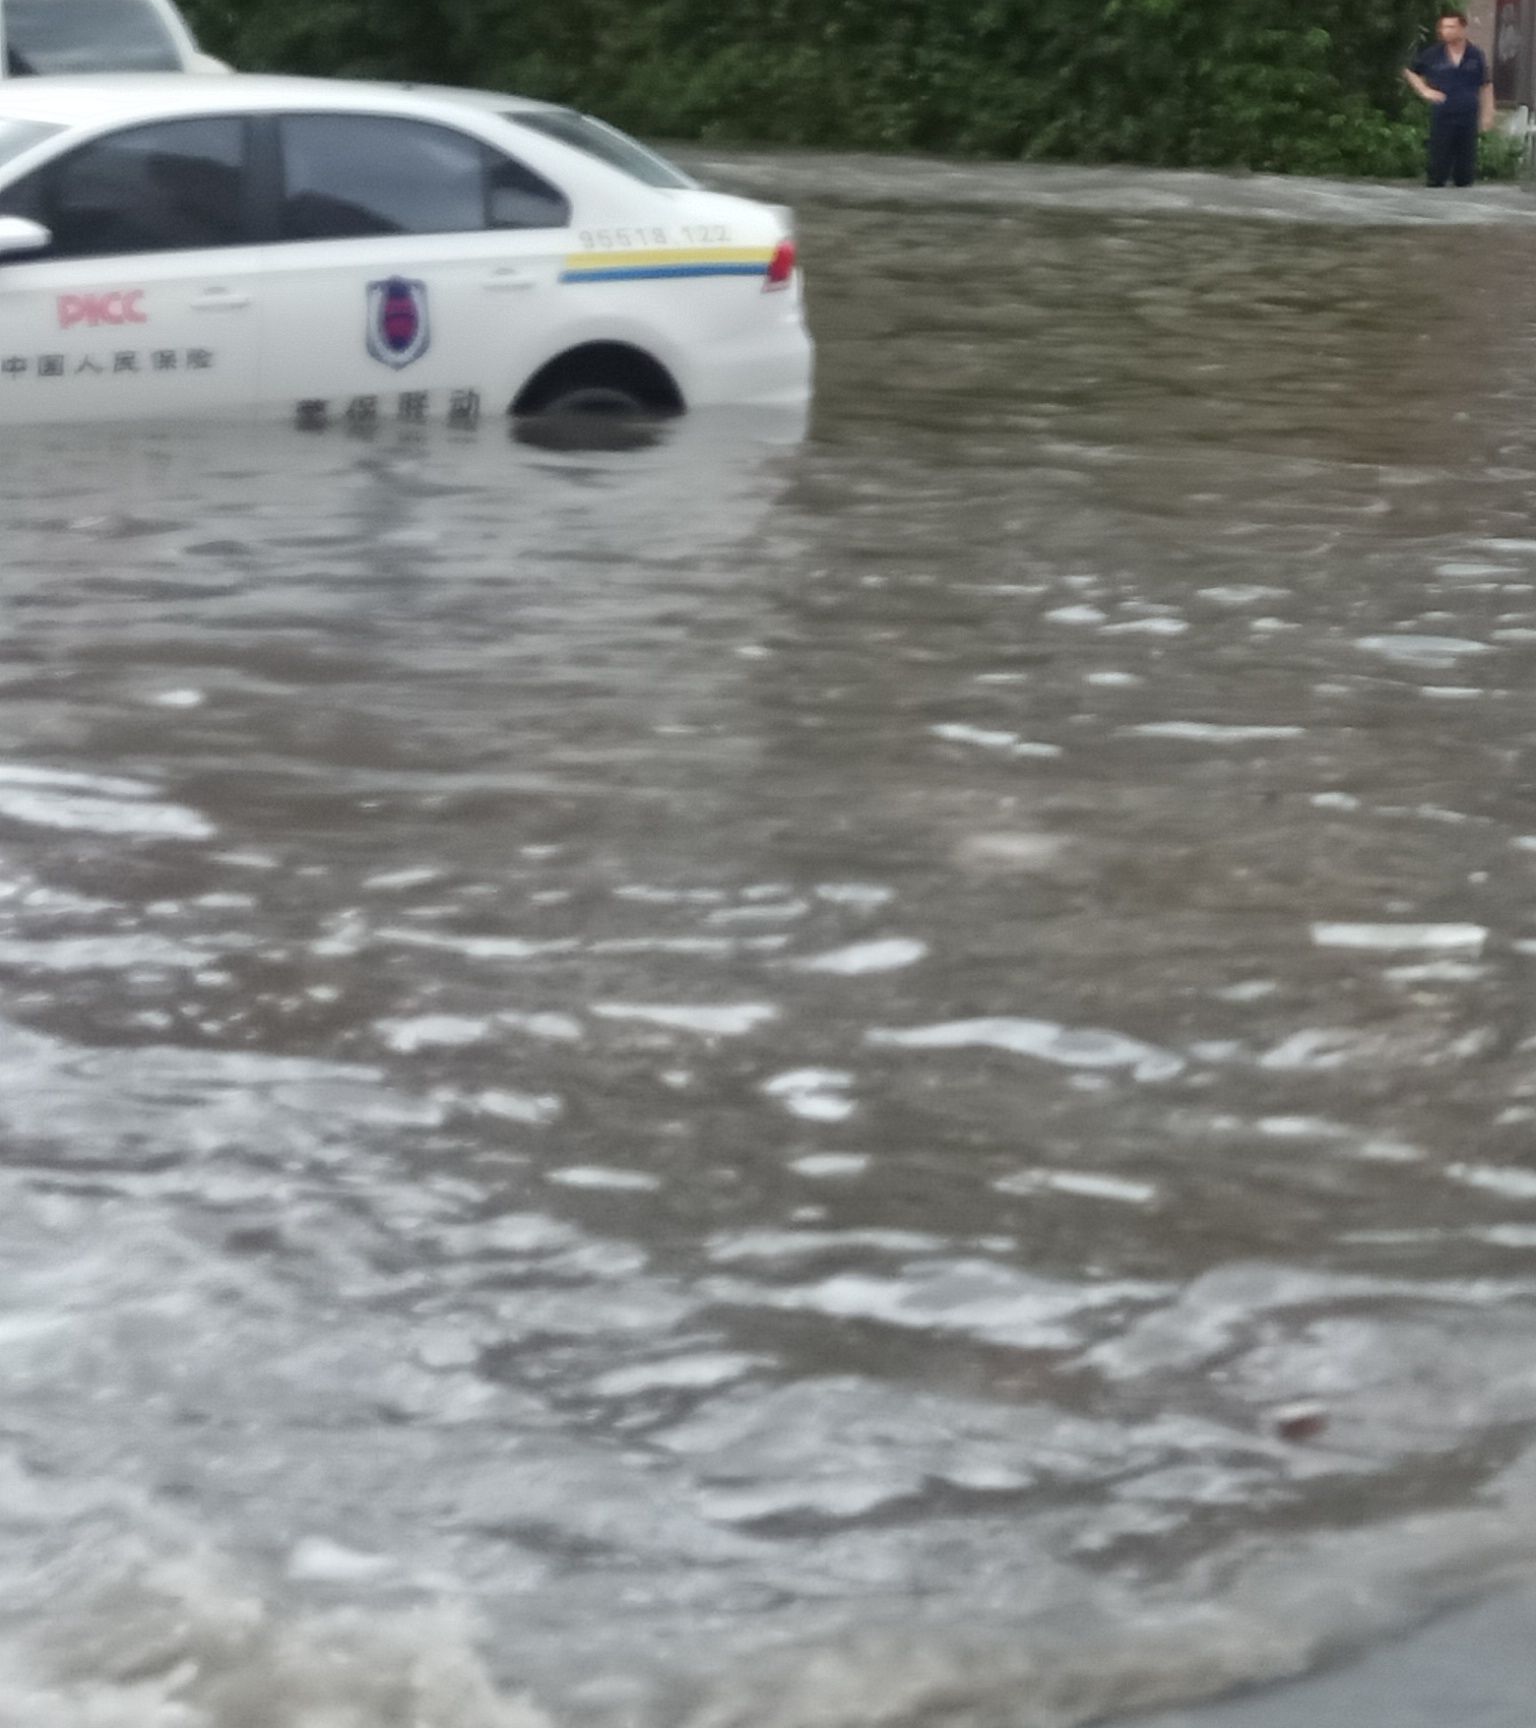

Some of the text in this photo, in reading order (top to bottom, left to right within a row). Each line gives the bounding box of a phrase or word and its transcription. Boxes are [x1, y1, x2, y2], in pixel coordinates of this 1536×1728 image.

[579, 228, 668, 250] 95518
[57, 289, 148, 330] PICC
[2, 348, 215, 380] 中国人民保险
